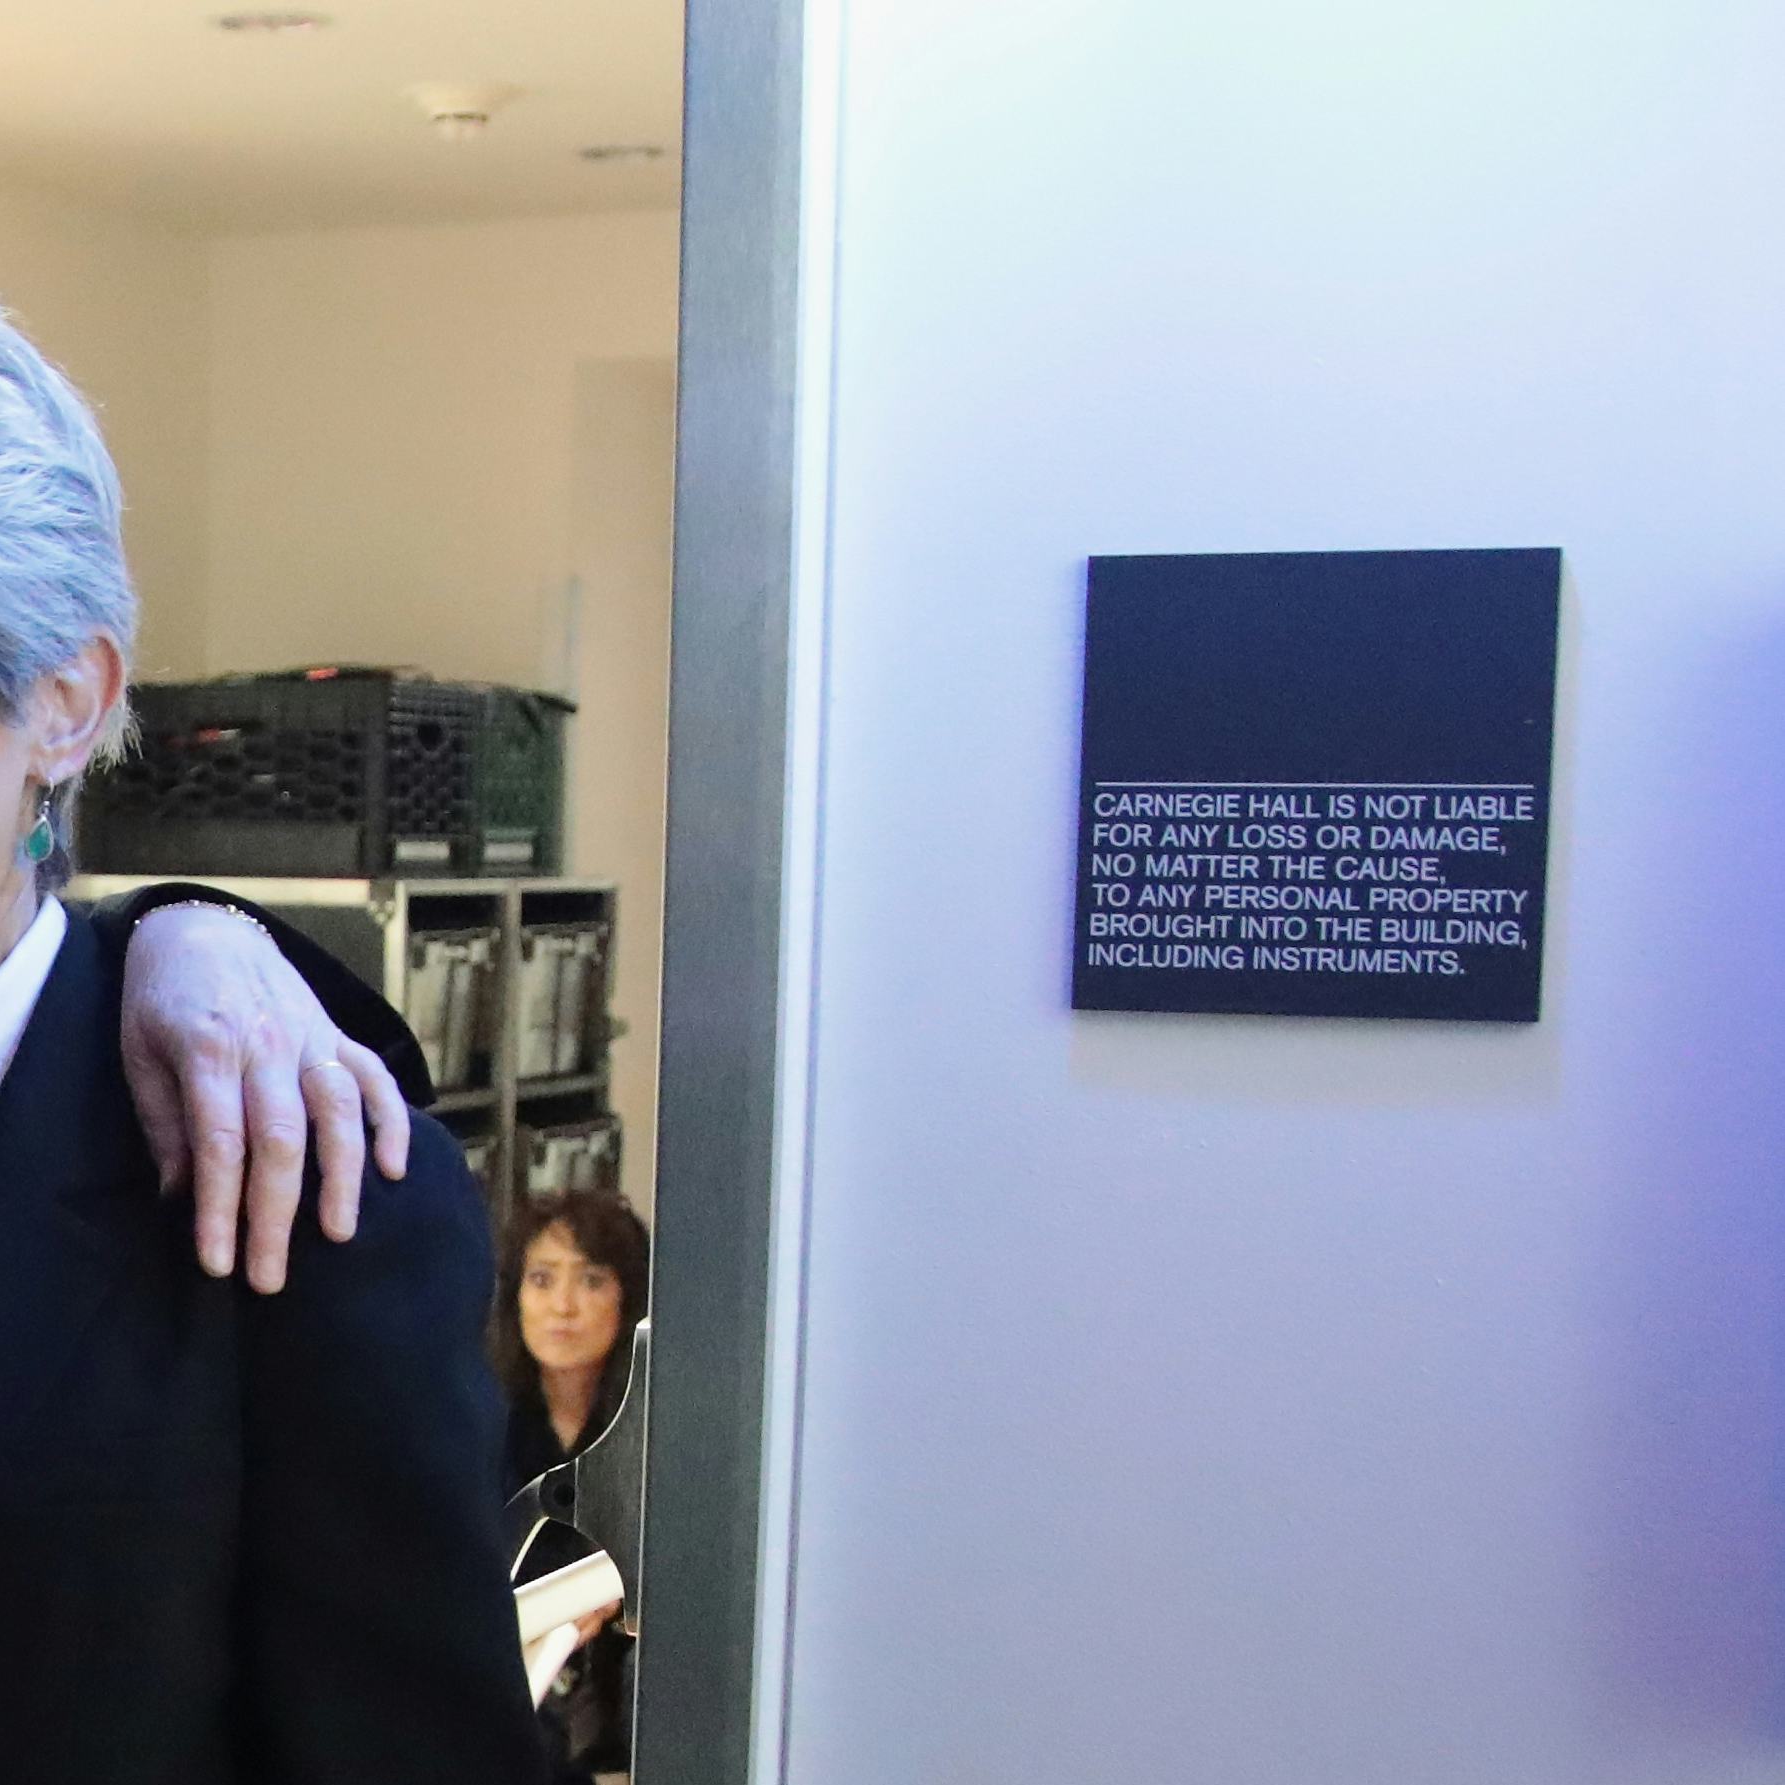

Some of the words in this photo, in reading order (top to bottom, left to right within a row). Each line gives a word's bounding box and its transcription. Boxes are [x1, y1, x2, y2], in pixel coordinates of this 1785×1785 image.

[1094, 793, 1241, 818] CARNEGIE
[1249, 794, 1321, 818] HALL
[1329, 794, 1356, 819] IS
[1364, 795, 1425, 819] NOT
[1434, 796, 1534, 820] LIABLE
[1094, 823, 1152, 846] FOR
[1160, 824, 1220, 848] ANY
[1228, 824, 1307, 849] LOSS
[1316, 825, 1361, 850] OR
[1370, 826, 1506, 855] DAMAGE,
[1092, 854, 1136, 876] NO
[1145, 854, 1260, 878] MATTER
[1268, 856, 1326, 880] THE
[1335, 856, 1446, 884] CAUSE,
[1092, 883, 1130, 906] TO
[1138, 884, 1196, 907] ANY
[1205, 885, 1360, 910] PERSONAL
[1369, 888, 1528, 914] PROPERTY
[1090, 913, 1233, 938] BROUGHT
[1240, 916, 1307, 940] INTO
[1315, 918, 1372, 942] THE
[1381, 918, 1526, 949] BUILDING,
[1088, 944, 1244, 970] INCLUDING
[1253, 946, 1464, 974] INSTRUMENTS.
